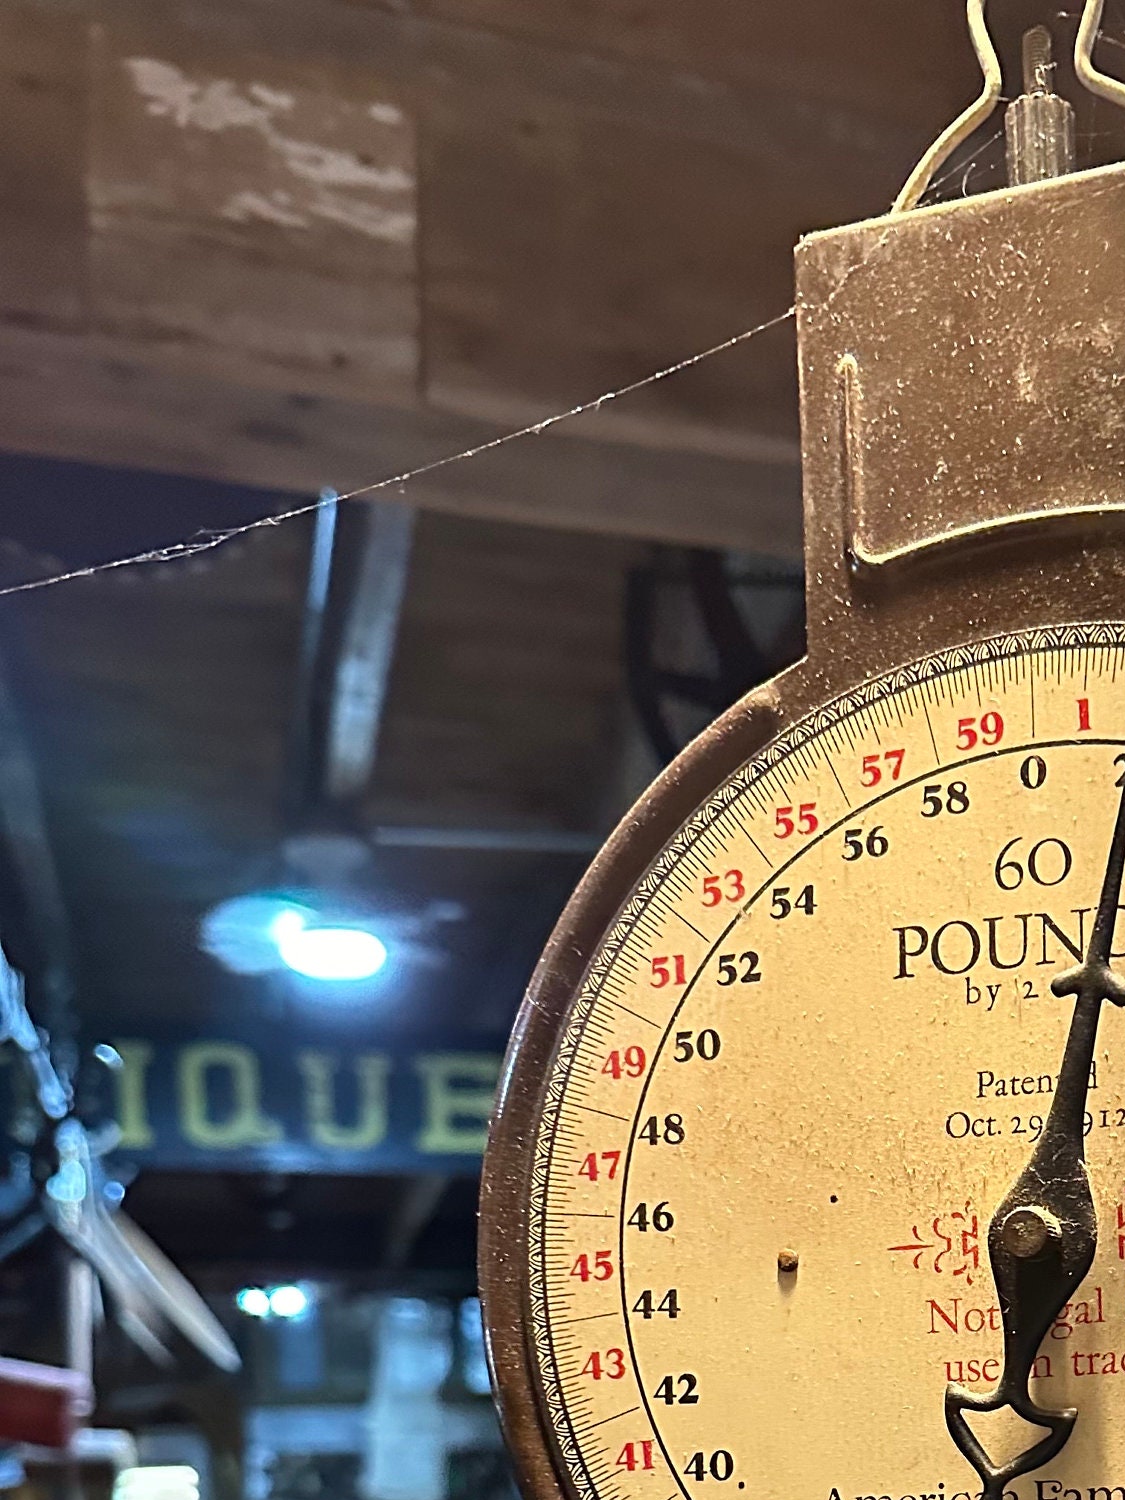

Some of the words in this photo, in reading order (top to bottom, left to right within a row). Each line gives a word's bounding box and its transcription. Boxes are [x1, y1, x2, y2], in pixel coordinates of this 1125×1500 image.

[958, 711, 1004, 750] 59
[1077, 698, 1091, 731] 1
[863, 749, 905, 787] 57
[1021, 756, 1046, 789] 0
[921, 782, 969, 817] 58
[776, 803, 819, 839] 55
[842, 826, 888, 860] 56
[995, 837, 1072, 890] 60
[703, 869, 745, 907] 53
[770, 885, 817, 919] 54
[651, 954, 685, 988] 51
[717, 951, 761, 986] 52
[966, 977, 1002, 1011] by
[1023, 981, 1038, 999] 2
[674, 1029, 720, 1062] 50
[601, 1046, 646, 1080] 49
[976, 1061, 1098, 1098] Patend
[0, 1038, 500, 1153] IQUE
[638, 1114, 684, 1145] 48
[946, 1112, 1001, 1138] Oct.
[578, 1150, 620, 1181] 47
[628, 1202, 673, 1231] 46
[570, 1250, 614, 1283] 45
[632, 1289, 680, 1319] 44
[926, 1298, 1001, 1334] Not
[1050, 1287, 1105, 1339] gal
[582, 1348, 626, 1380] 43
[944, 1358, 999, 1382] use
[1032, 1354, 1053, 1378] n
[654, 1374, 698, 1405] 42
[616, 1440, 654, 1471] 41
[684, 1450, 733, 1481] 40
